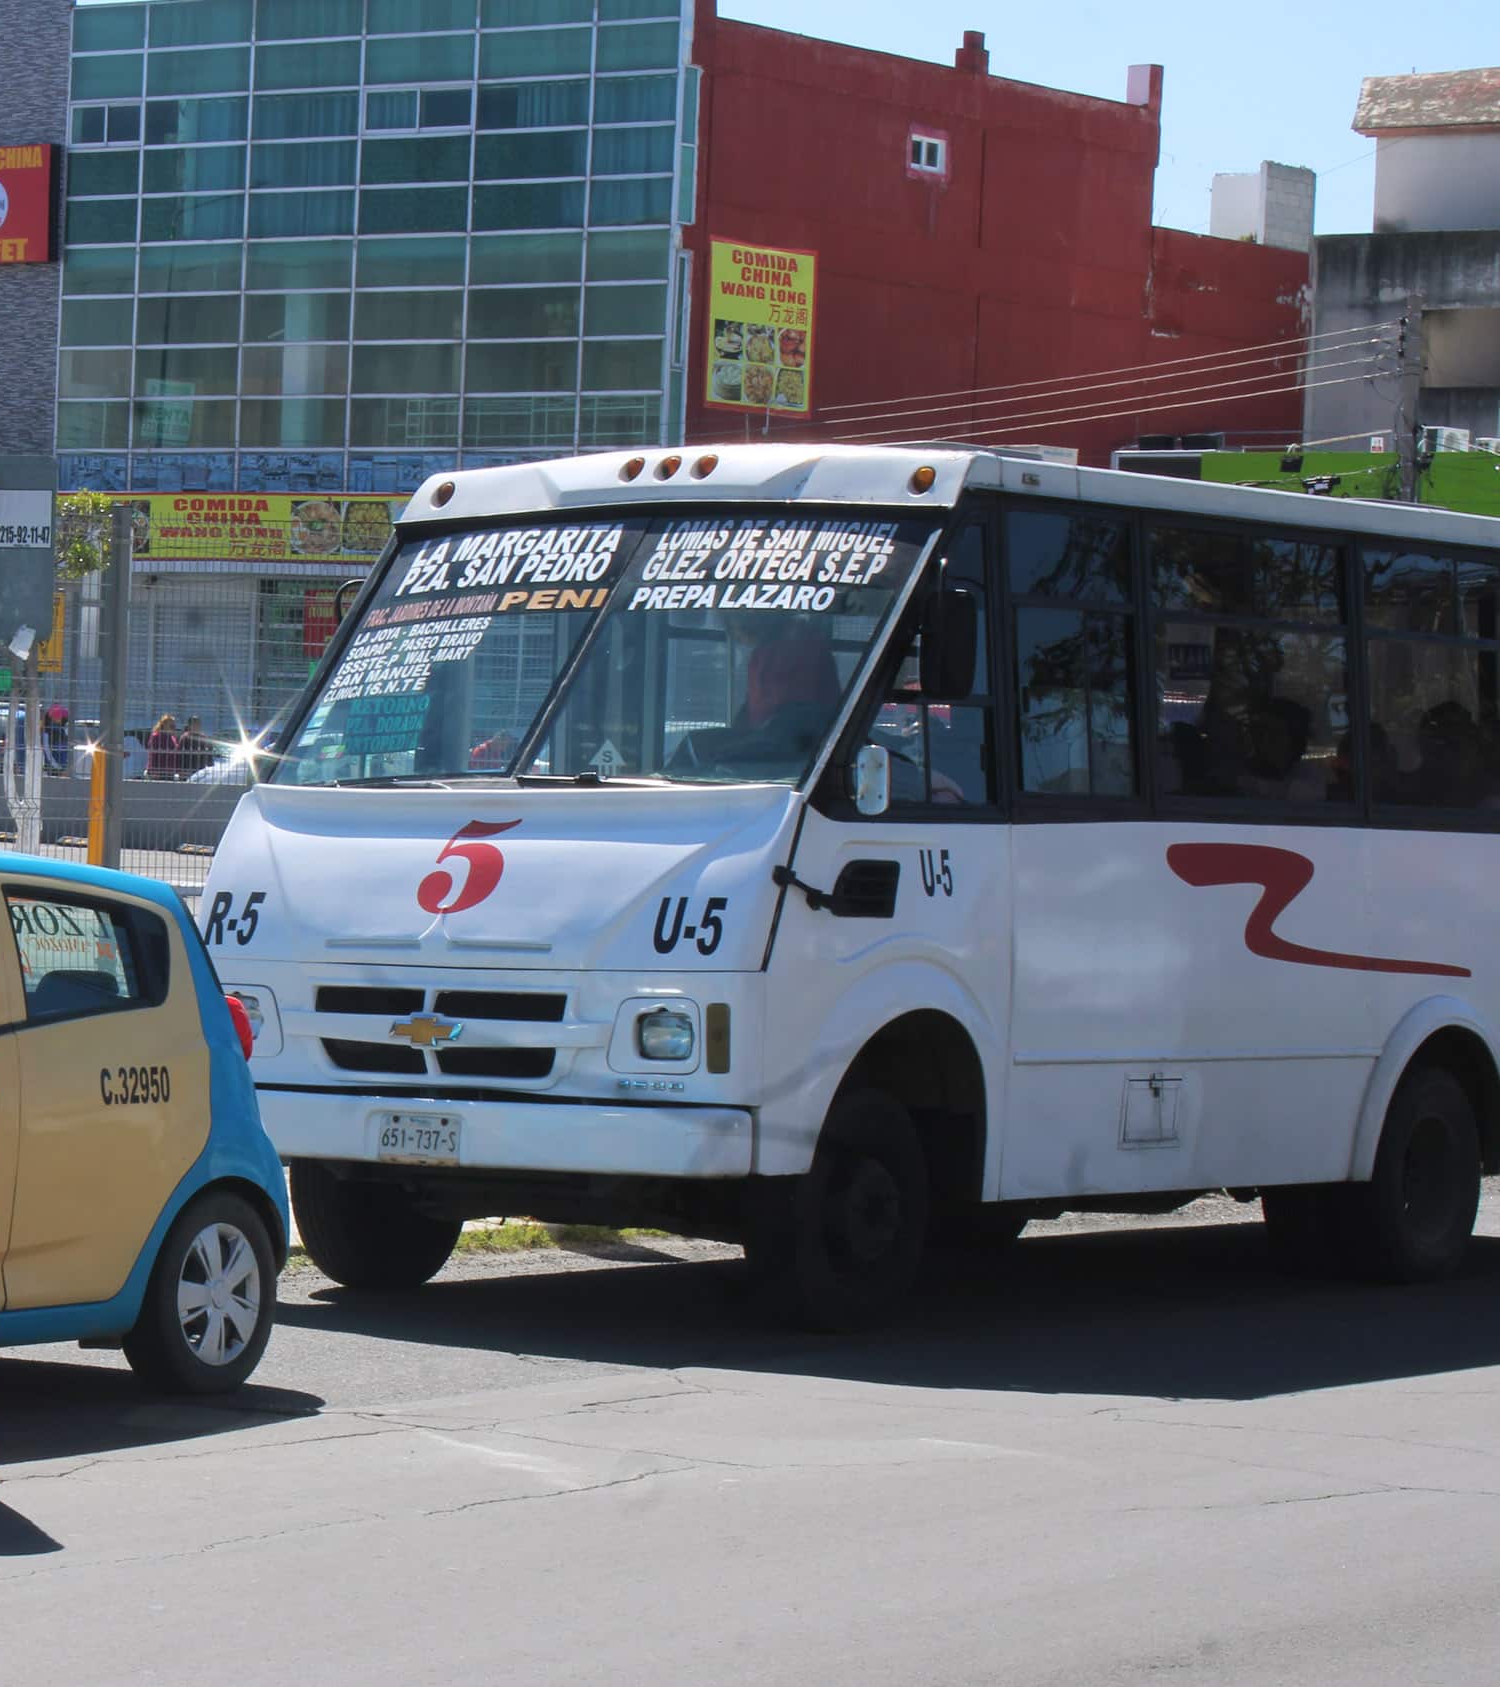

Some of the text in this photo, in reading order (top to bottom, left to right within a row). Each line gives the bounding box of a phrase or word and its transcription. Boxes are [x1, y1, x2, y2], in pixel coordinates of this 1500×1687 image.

[732, 250, 798, 272] COMIDA
[741, 267, 792, 288] CHINA
[721, 281, 807, 305] WANG LONG
[173, 498, 269, 511] COMIDA
[187, 511, 261, 525] CHINA
[160, 526, 222, 538] WANG
[655, 520, 899, 554] LOMAS DE SAN MIGUEL
[411, 524, 624, 568] LA MARGARITA
[395, 551, 612, 596] PZA. SAN PEDRO
[641, 549, 888, 584] GLEZ. ORTEGA S.E.P
[497, 588, 609, 611] PENI
[627, 584, 836, 611] PREPA LAZARO
[353, 617, 492, 646] LA JOYA BACHILLERES
[346, 632, 483, 661] SOAPAP PASEO BRAVO
[404, 646, 475, 664] WAL-MART
[330, 663, 432, 689] SAN MANUEL
[348, 694, 430, 715] RETORNO
[417, 819, 523, 914] 5
[920, 849, 953, 897] U-5
[204, 892, 267, 945] R-5
[653, 897, 728, 956] U-5
[101, 1065, 170, 1105] C.32950
[381, 1128, 457, 1152] 651-737-S
